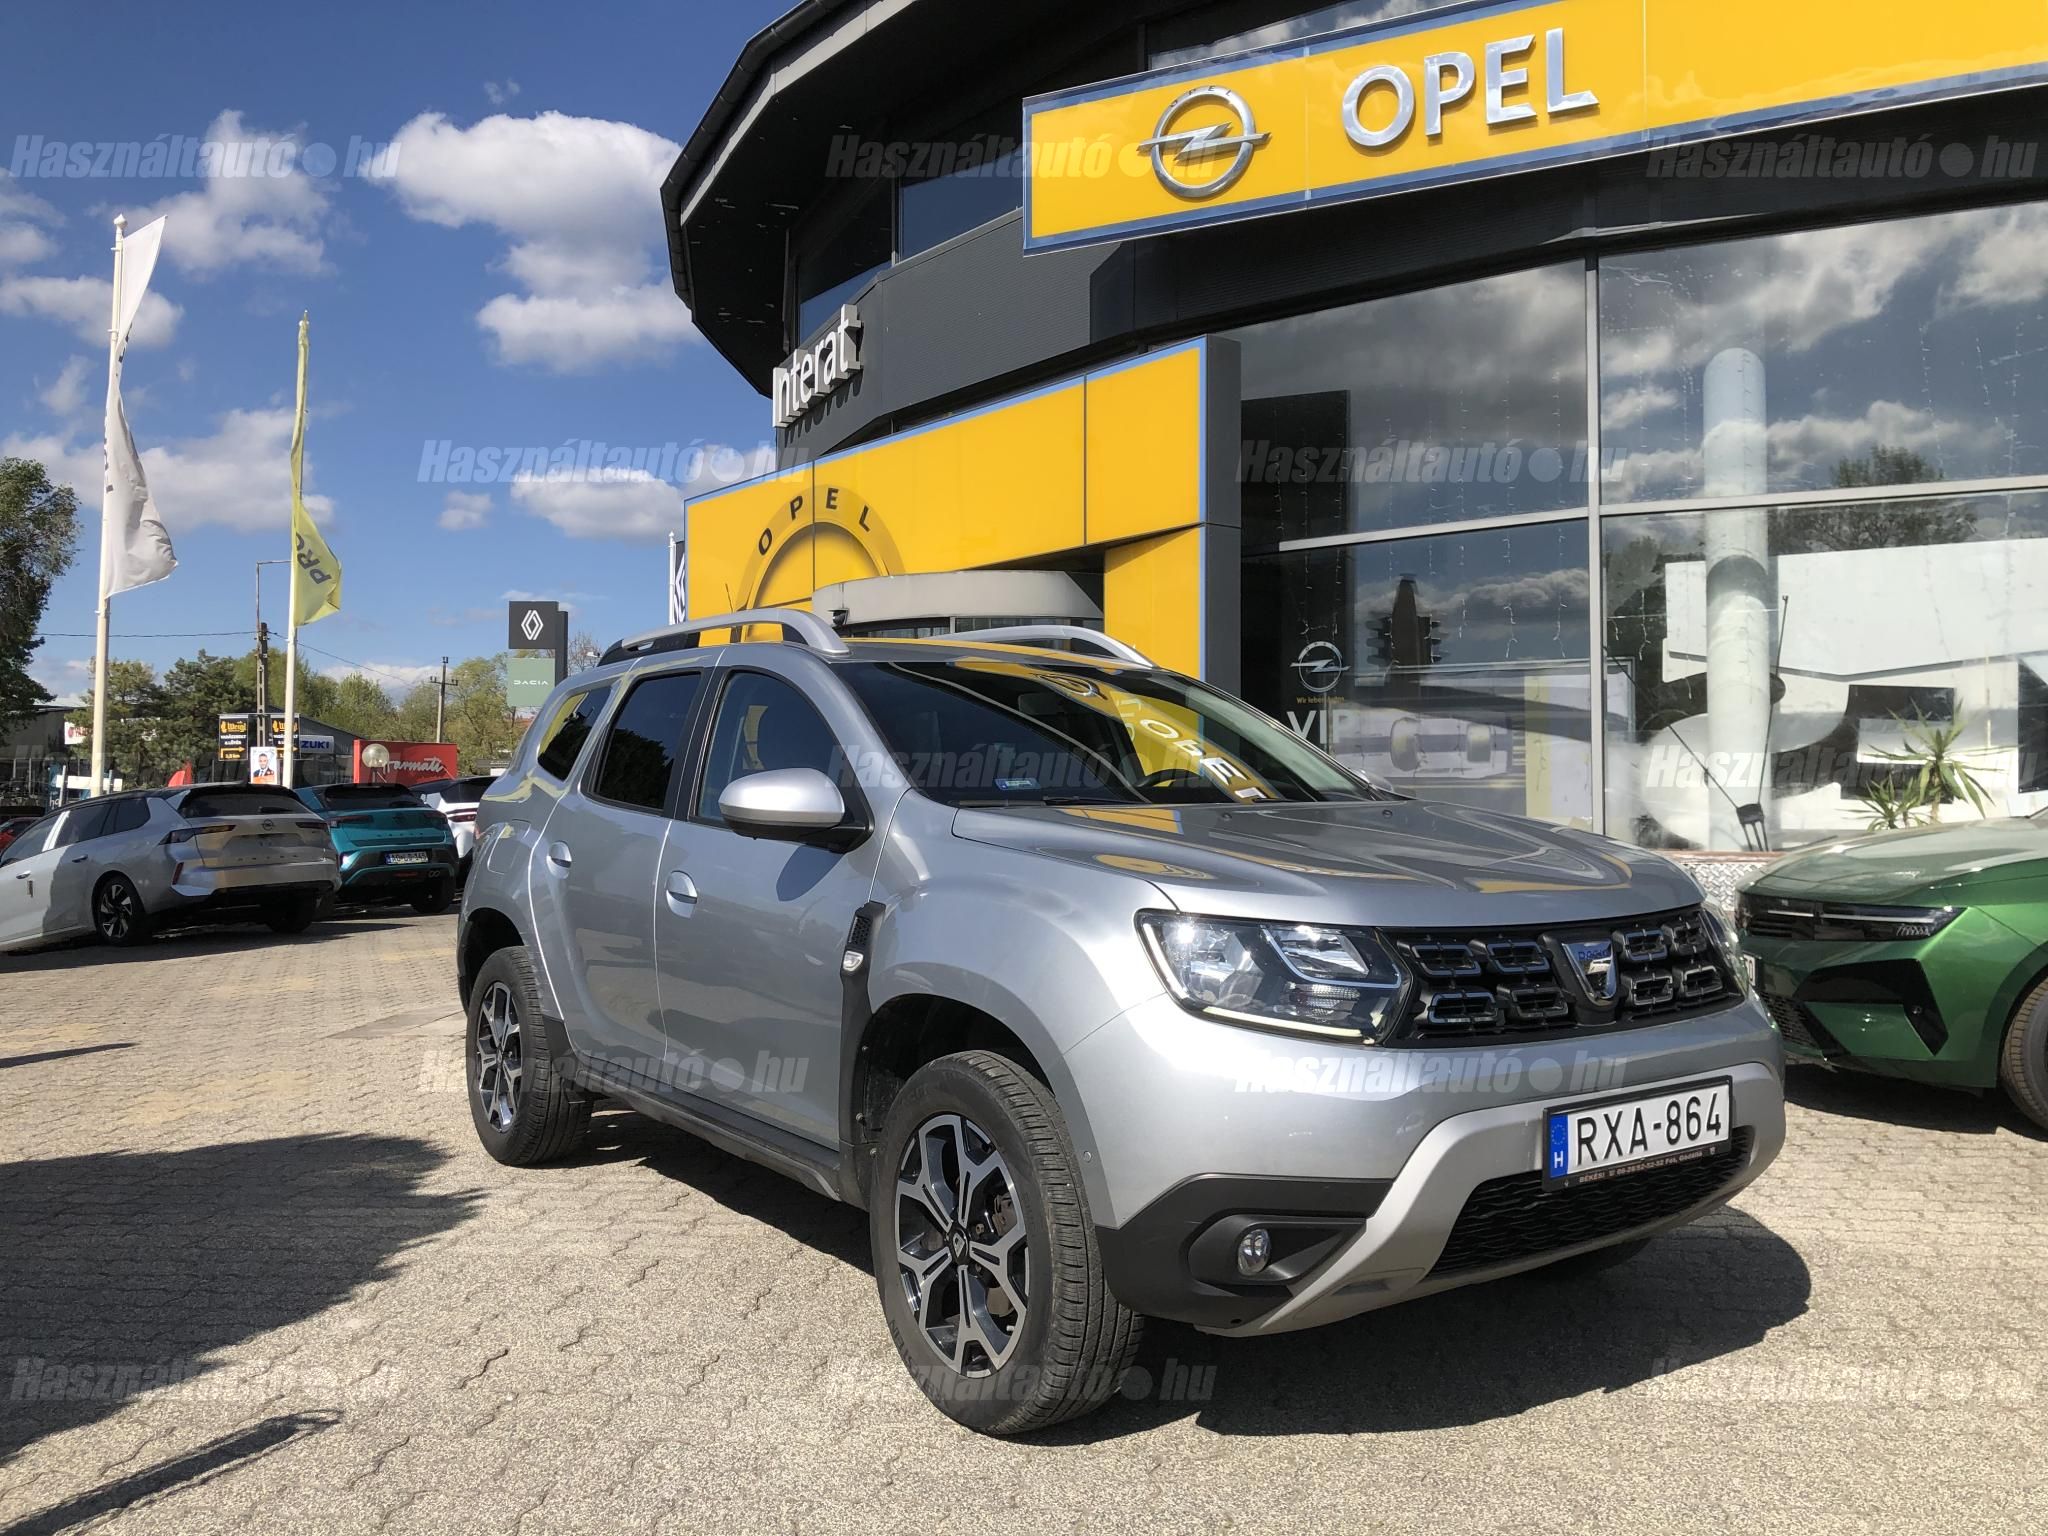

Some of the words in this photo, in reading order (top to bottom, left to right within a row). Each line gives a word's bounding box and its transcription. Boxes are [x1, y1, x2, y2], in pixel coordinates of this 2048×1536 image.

[1170, 85, 1232, 108] OPEL
[1340, 27, 1600, 147] OPEL
[758, 487, 871, 556] OPEL
[300, 741, 330, 749] ZUKI
[1577, 1093, 1721, 1166] RXA-864
[1553, 1151, 1564, 1168] H
